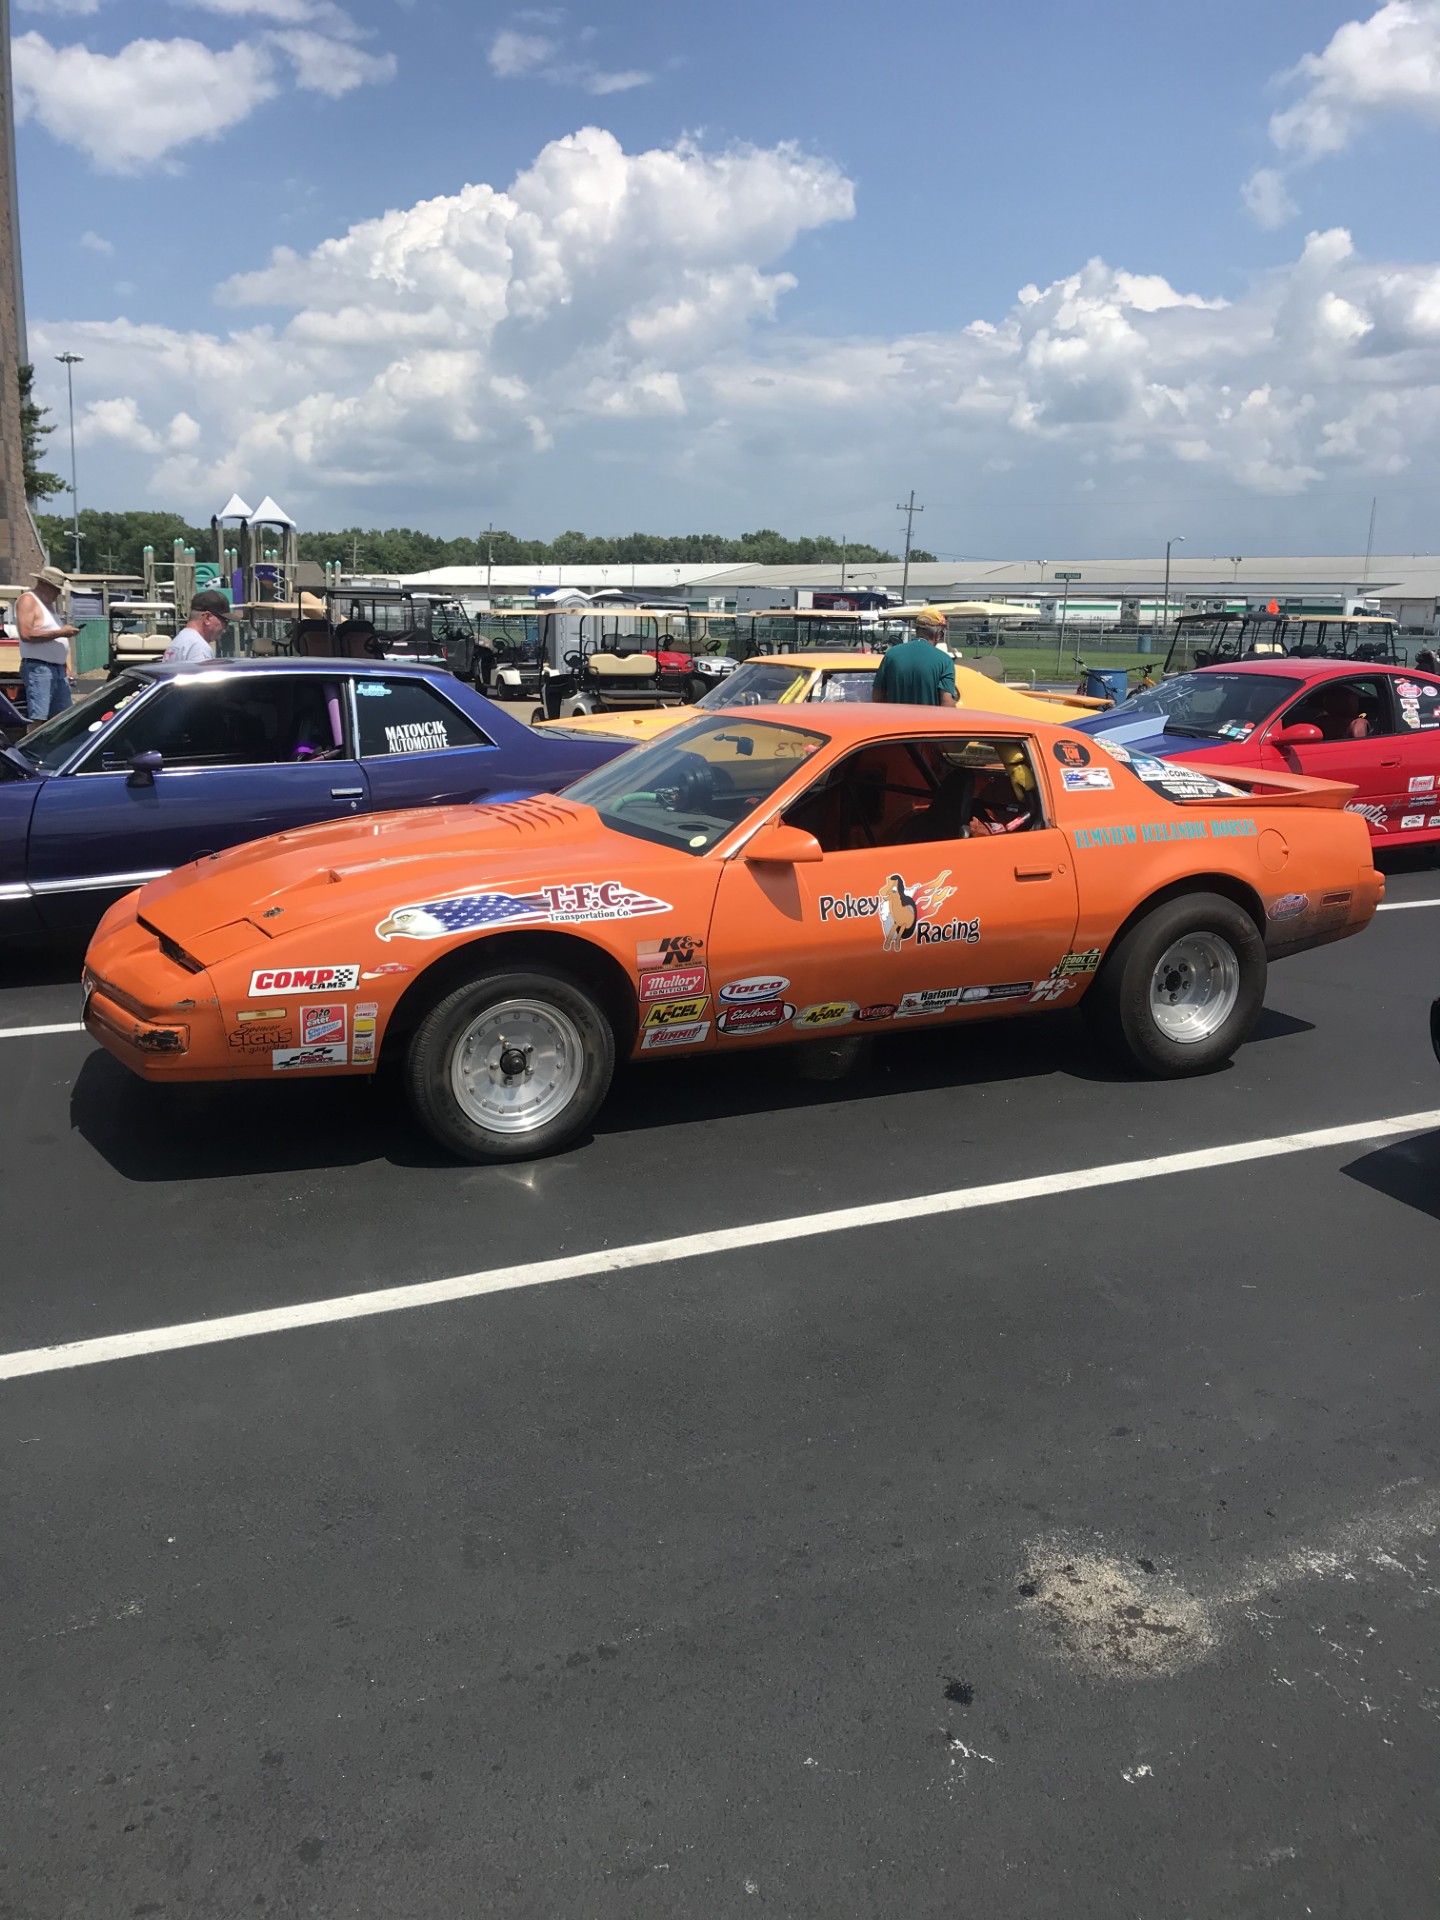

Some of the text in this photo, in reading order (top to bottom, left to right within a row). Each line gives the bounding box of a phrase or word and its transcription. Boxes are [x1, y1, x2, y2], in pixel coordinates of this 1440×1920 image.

[385, 721, 447, 740] MATOVCIK
[389, 734, 449, 752] AUTOMOTIVE
[1074, 818, 1258, 849] ELMVIEW ICELANDIC HORSES
[544, 883, 631, 911] T.F.C.
[549, 908, 631, 921] Transportation Co.
[820, 894, 879, 920] Pokey
[917, 918, 980, 944] Racing
[1066, 956, 1086, 964] COOL
[255, 969, 335, 990] COMP
[309, 982, 346, 990] CAMS
[648, 975, 701, 990] Mallory
[650, 986, 689, 996] IGNITION
[728, 981, 783, 995] Torco
[920, 988, 958, 1001] Harland
[731, 1006, 778, 1020] Edelbrock
[233, 1022, 281, 1036] Spencer
[306, 1016, 330, 1027] eater
[229, 1028, 292, 1047] SIGNS
[650, 1026, 702, 1046] SUMMIT
